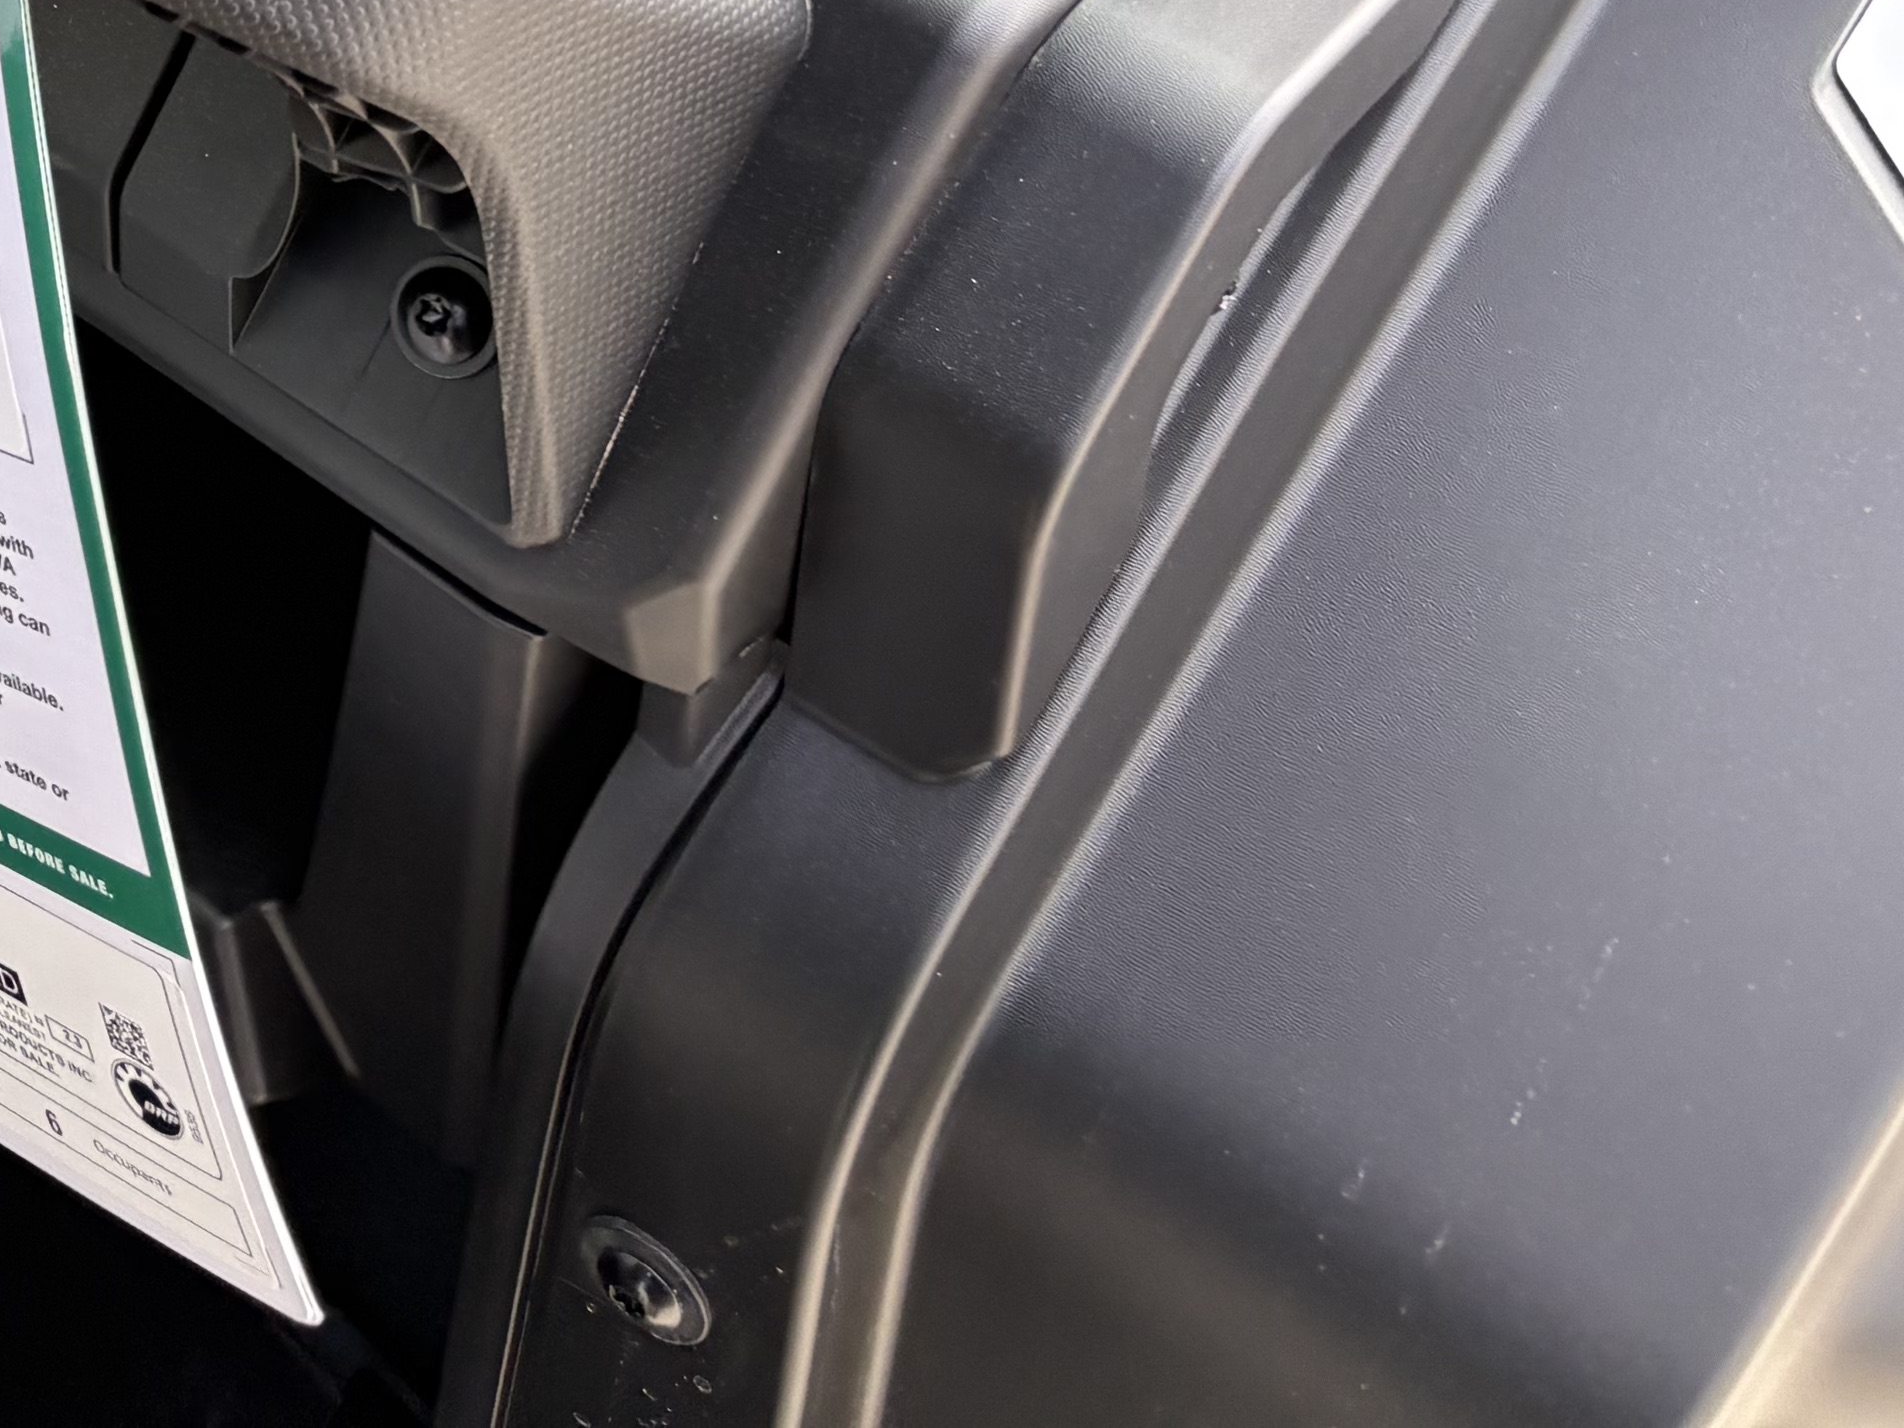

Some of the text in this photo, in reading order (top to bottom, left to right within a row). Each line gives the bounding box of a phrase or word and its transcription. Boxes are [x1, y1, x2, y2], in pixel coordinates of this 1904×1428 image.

[18, 614, 50, 636] can
[5, 761, 46, 790] state
[52, 784, 69, 800] or
[7, 833, 65, 873] BEFORE
[69, 865, 113, 898] SALE.
[46, 1109, 62, 1136] 6
[93, 1139, 172, 1196] Occupants
